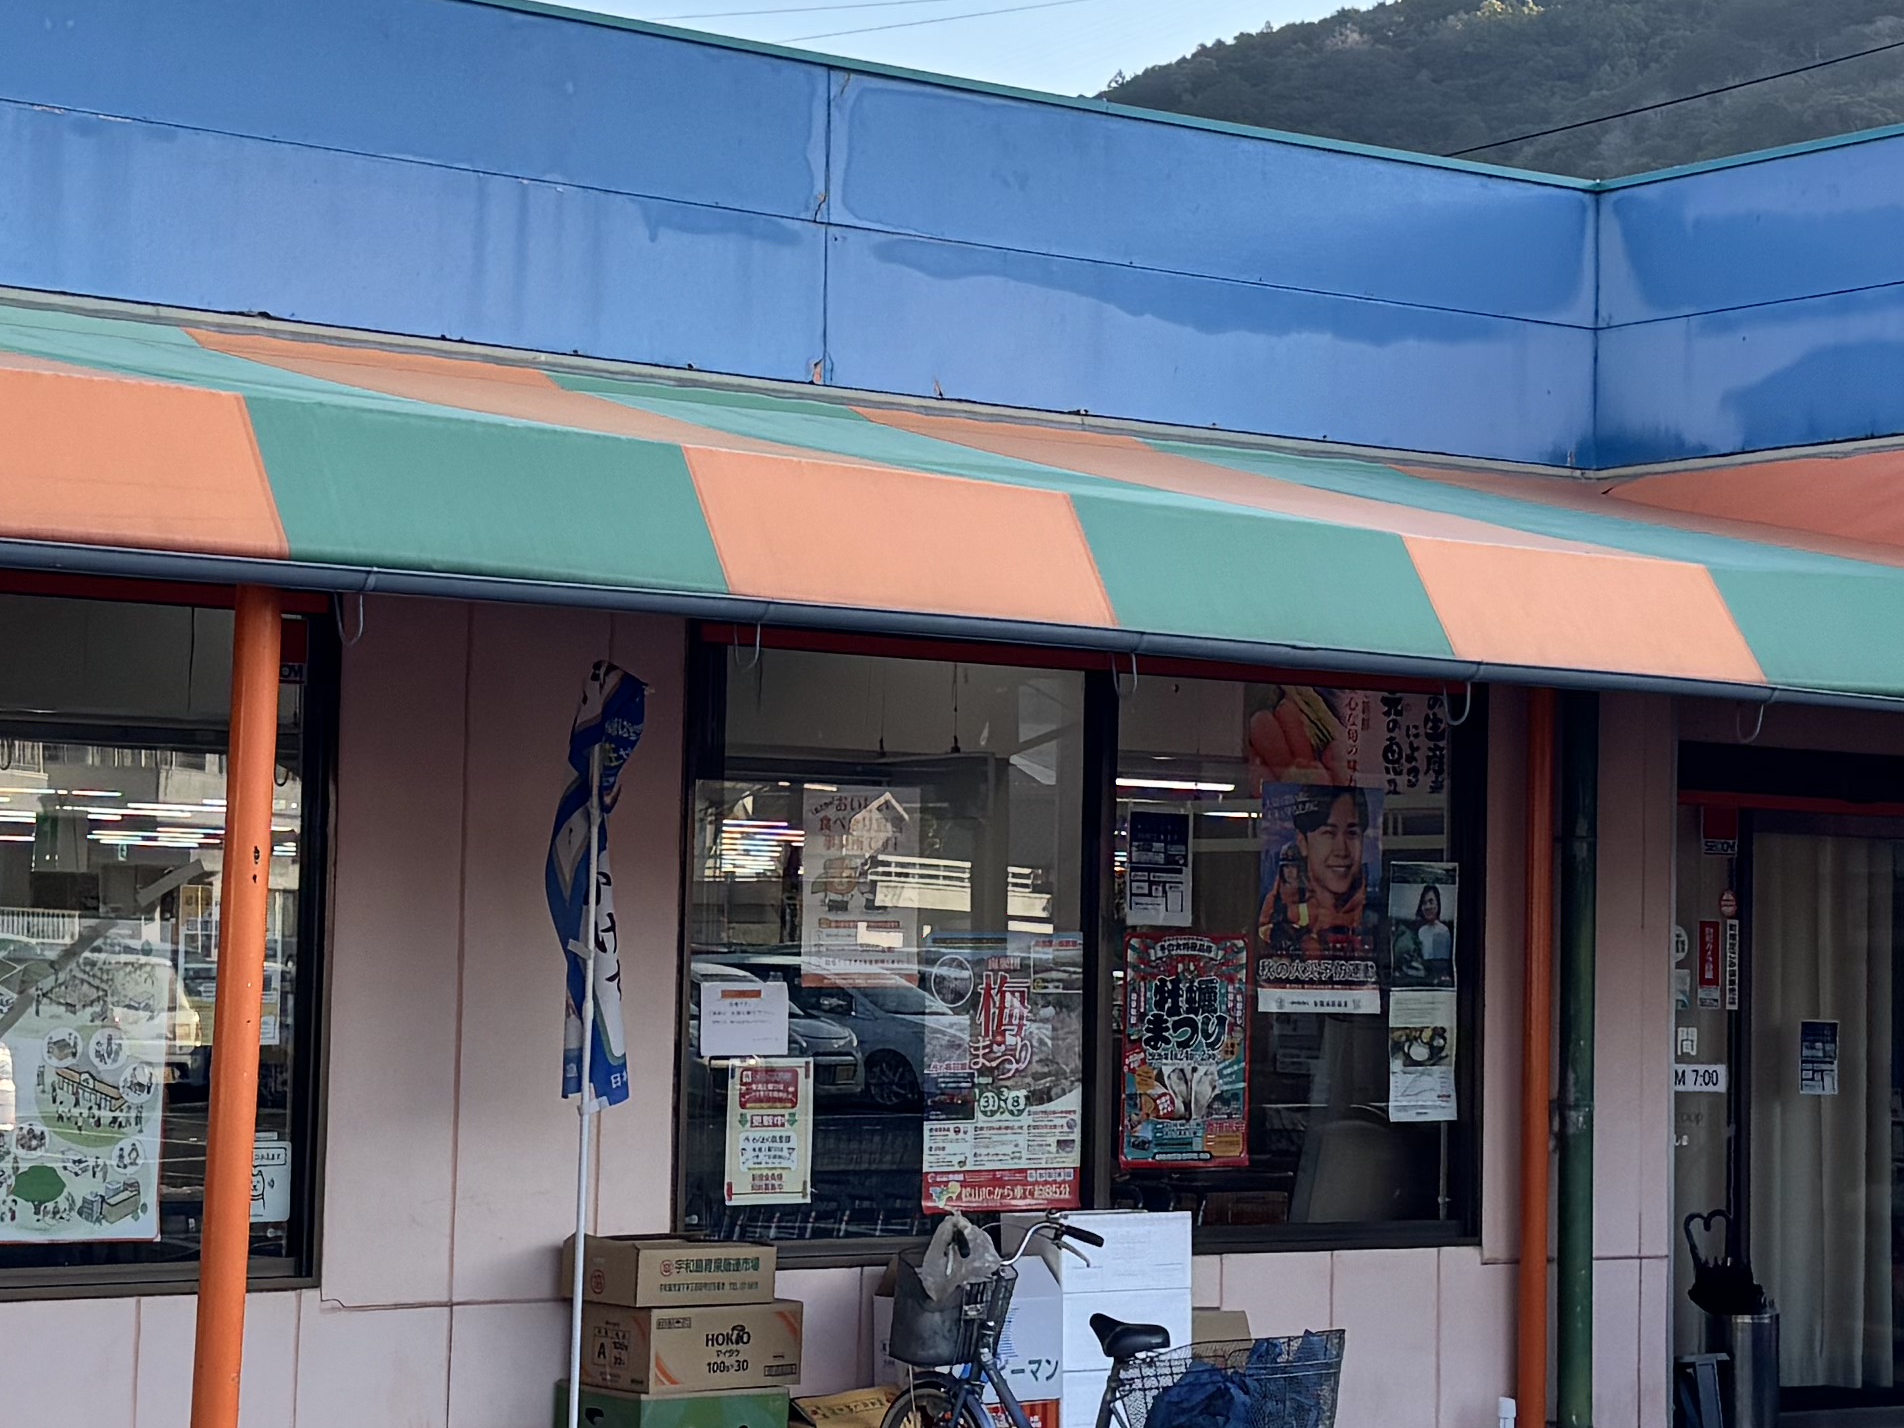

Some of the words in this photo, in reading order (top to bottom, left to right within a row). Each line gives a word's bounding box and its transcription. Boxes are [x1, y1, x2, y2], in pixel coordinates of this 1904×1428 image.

[1405, 724, 1421, 788] による
[976, 971, 1032, 1043] 梅
[1143, 1012, 1228, 1051] まつり
[969, 1035, 1032, 1080] まつり
[1691, 1069, 1719, 1086] 7:00
